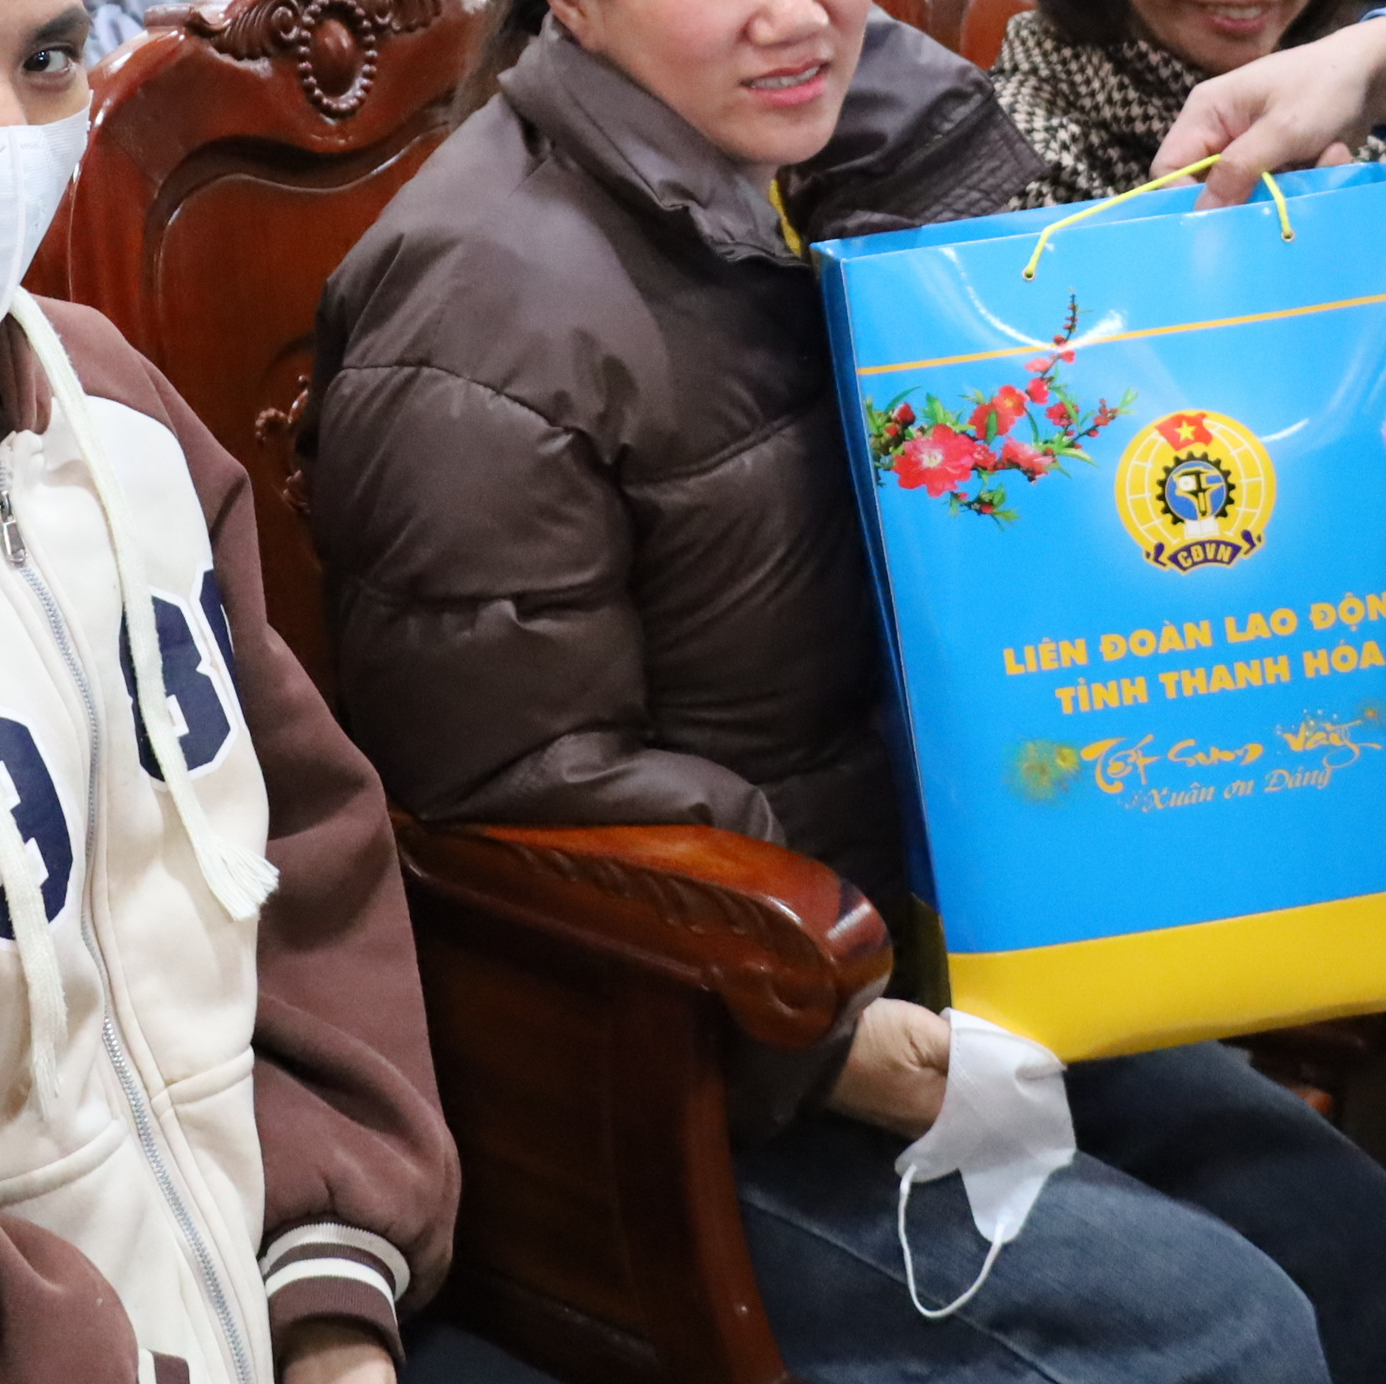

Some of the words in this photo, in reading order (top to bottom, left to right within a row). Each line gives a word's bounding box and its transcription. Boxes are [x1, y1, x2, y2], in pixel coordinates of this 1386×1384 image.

[1002, 636, 1088, 675] LIÊN
[1099, 620, 1213, 662] ĐOÀN
[1224, 607, 1298, 643] LAO
[1055, 677, 1149, 714] TỈNH
[1158, 655, 1291, 700] THANH
[1302, 639, 1386, 678] HÓA
[1141, 781, 1215, 813] Xuân
